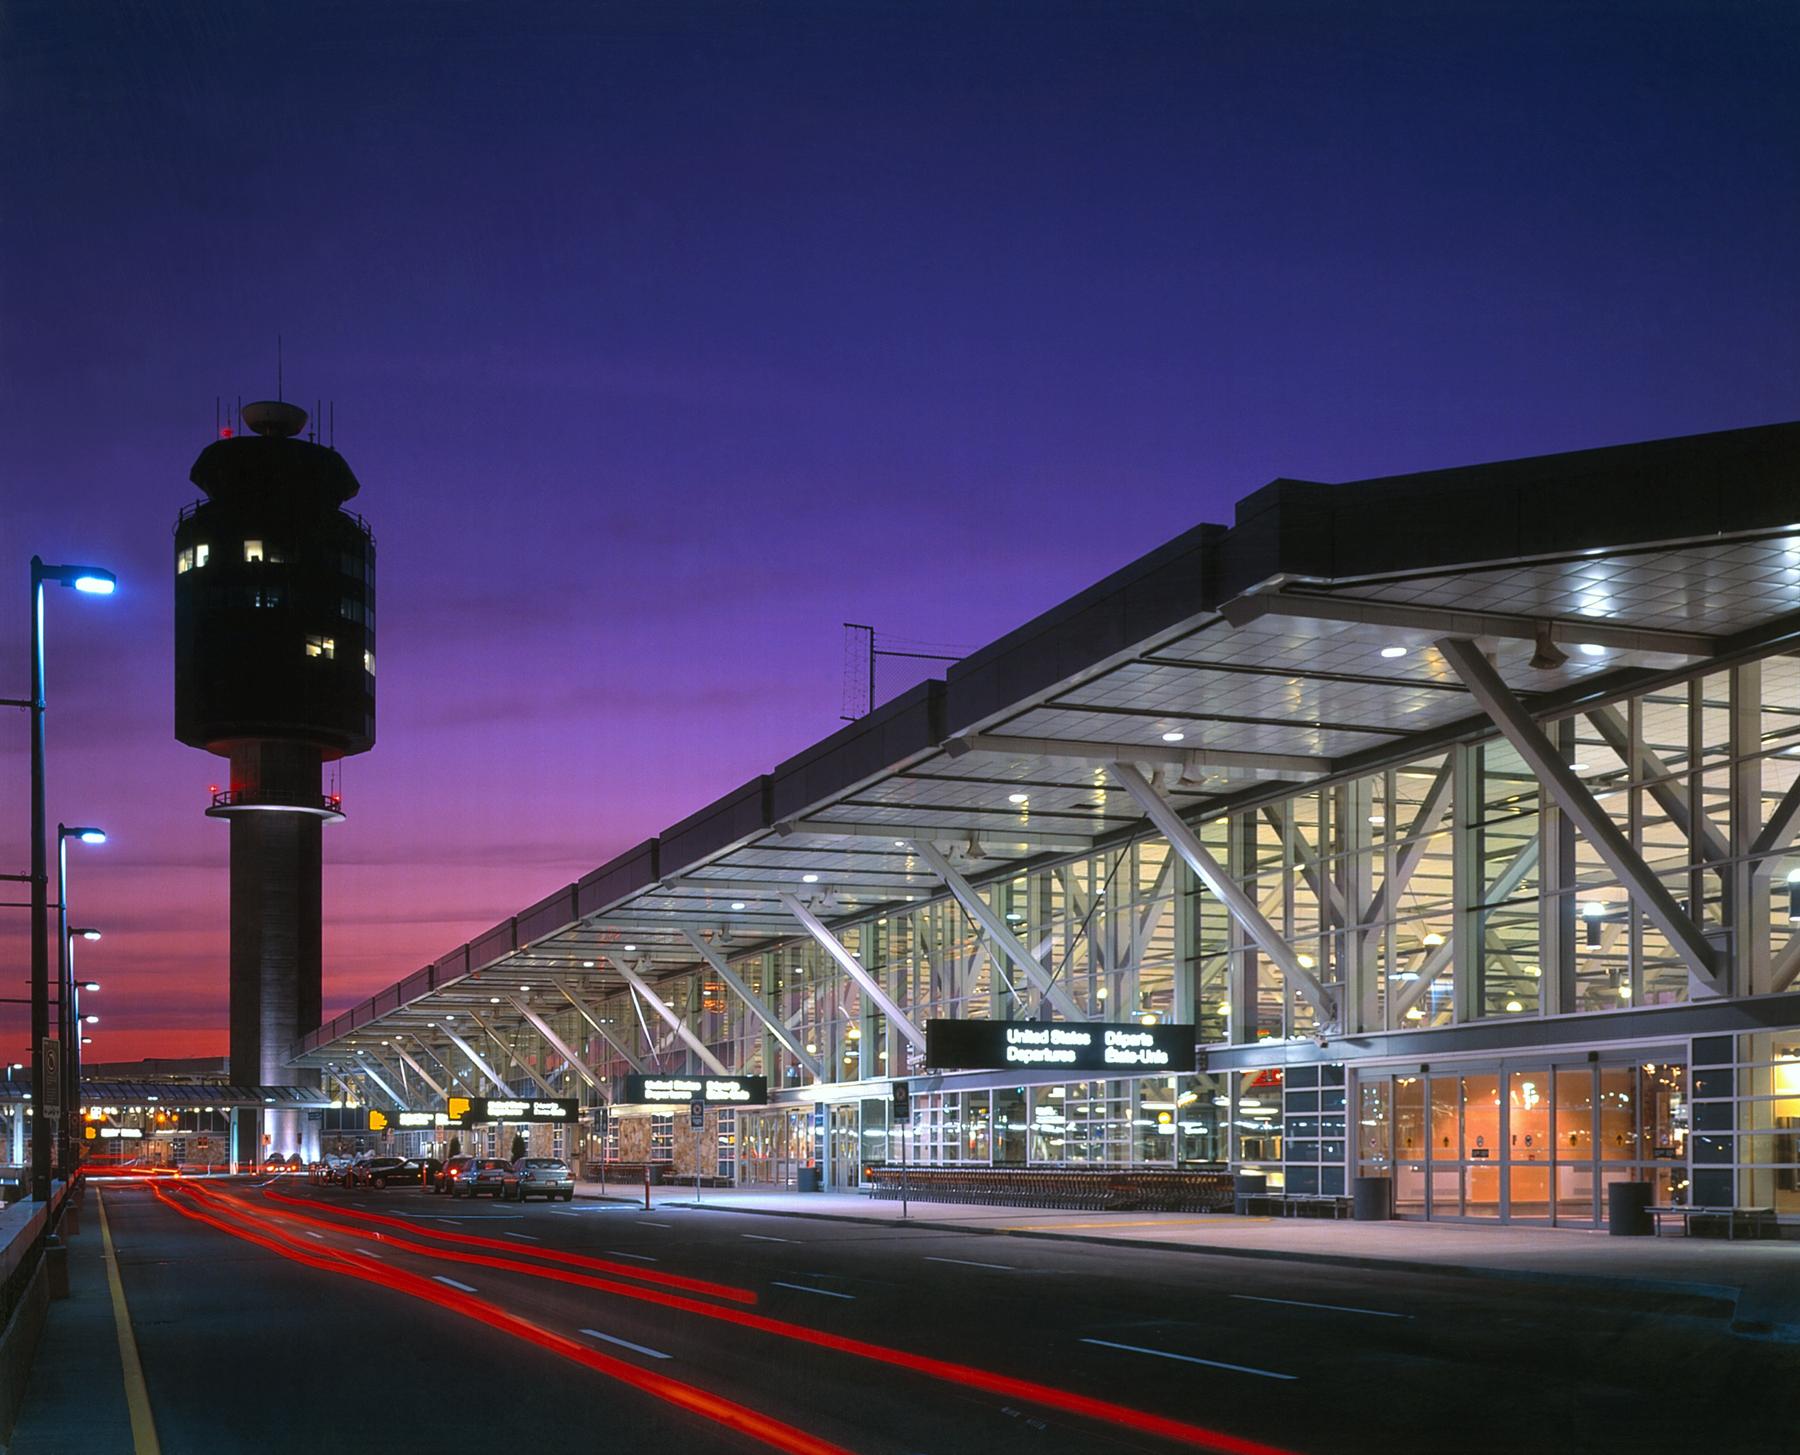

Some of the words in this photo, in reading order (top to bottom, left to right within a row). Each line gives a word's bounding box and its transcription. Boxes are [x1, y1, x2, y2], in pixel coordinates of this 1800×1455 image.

[1007, 1029, 1049, 1044] United
[1051, 1030, 1091, 1045] States
[1007, 1046, 1075, 1063] Departures
